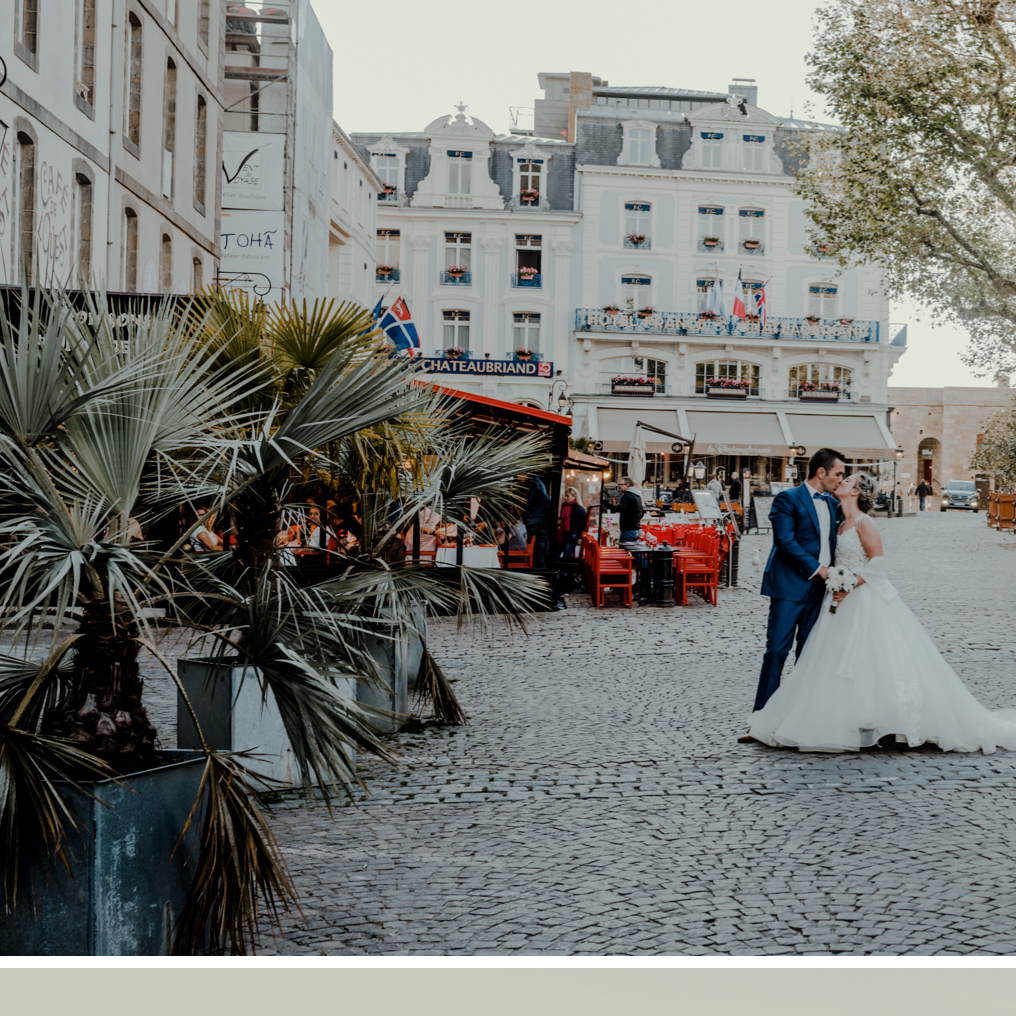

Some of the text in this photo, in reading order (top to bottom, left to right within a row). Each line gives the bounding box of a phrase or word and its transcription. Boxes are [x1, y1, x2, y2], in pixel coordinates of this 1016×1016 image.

[222, 192, 267, 200] elier-boutique
[644, 316, 706, 330] FRANCE
[740, 320, 870, 337] CHATEAUBRIAND
[421, 359, 536, 374] CHATEAUBRIAND
